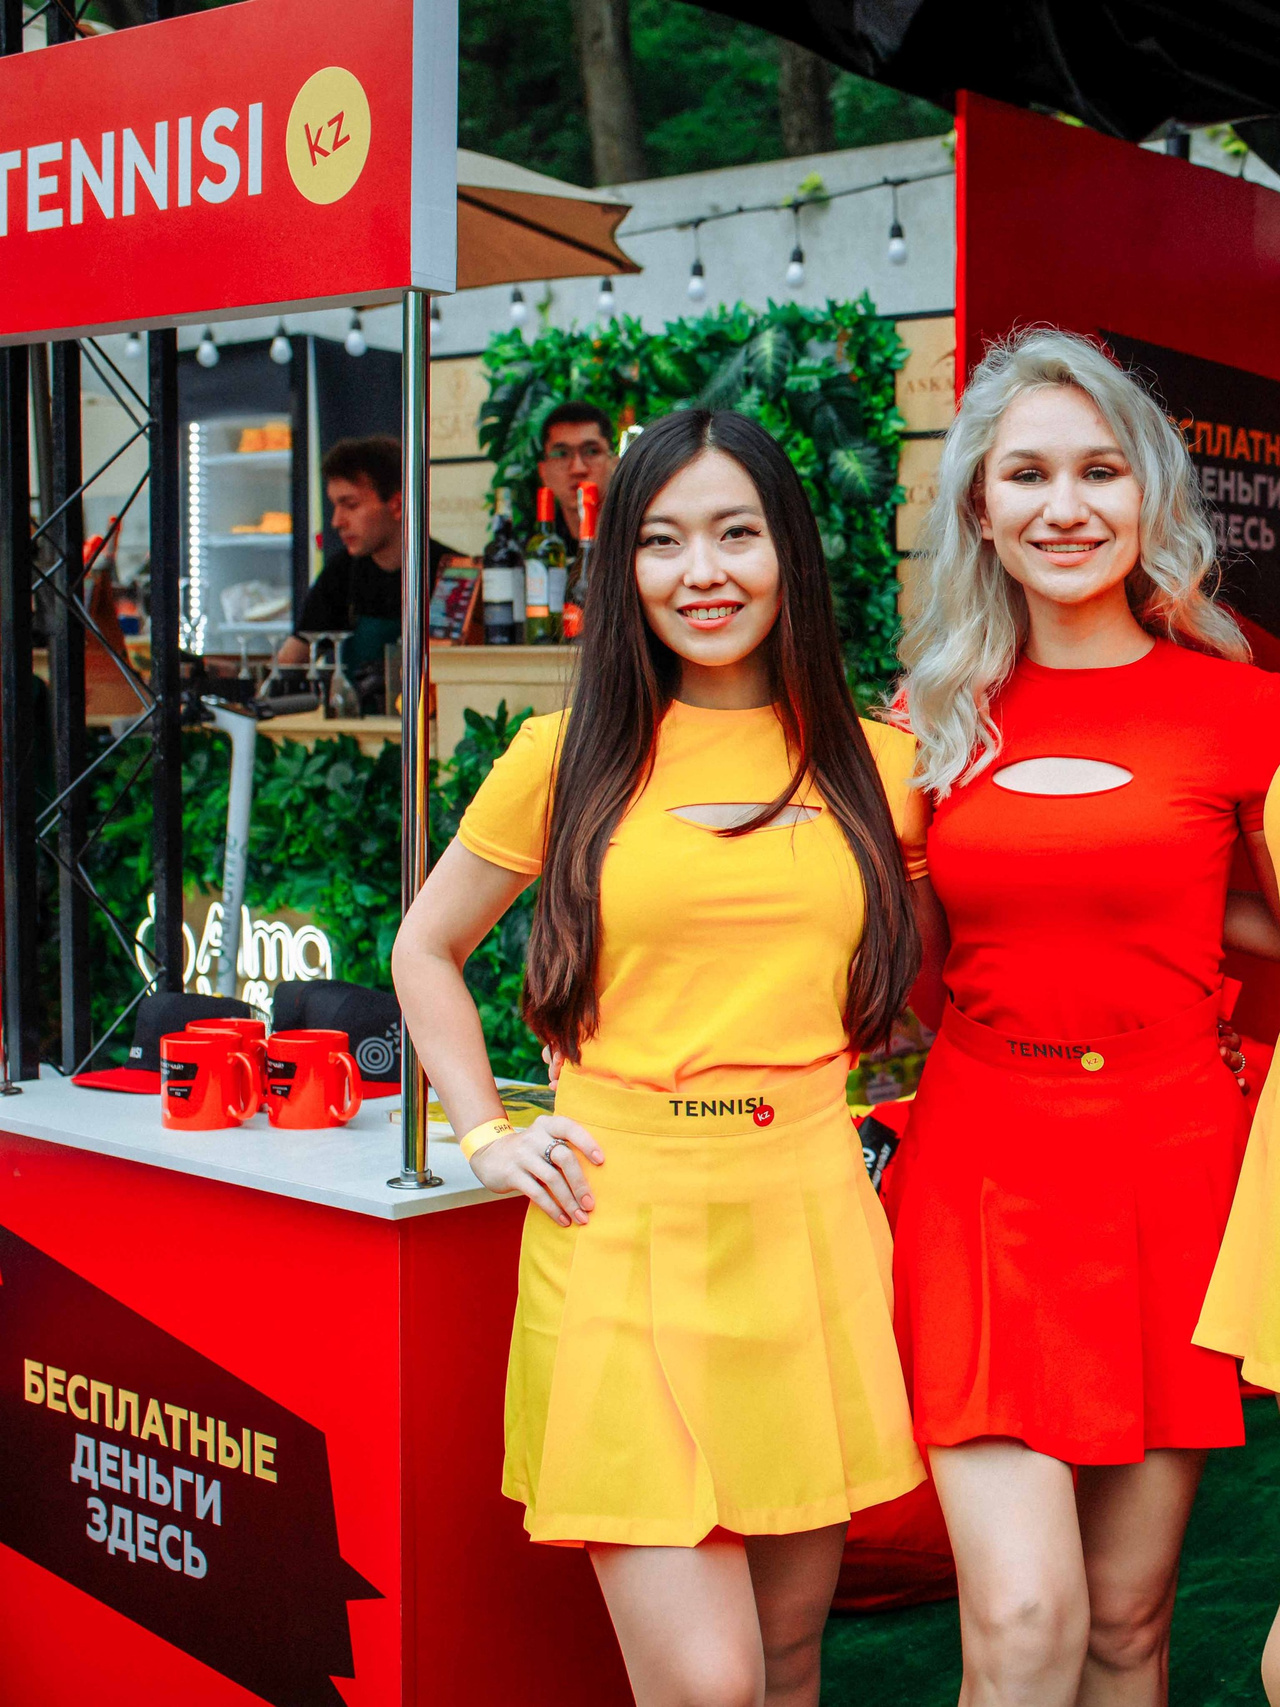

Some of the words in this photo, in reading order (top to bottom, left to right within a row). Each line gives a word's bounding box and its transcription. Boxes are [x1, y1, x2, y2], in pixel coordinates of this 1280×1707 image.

[1210, 511, 1276, 552] ДЕСЬ
[669, 1096, 764, 1117] TENNISI
[24, 1358, 278, 1484] БЕСПЛАТНЫЕ
[70, 1432, 222, 1526] ДЕНЬГИ
[86, 1497, 208, 1579] ЗДЕСЬ
